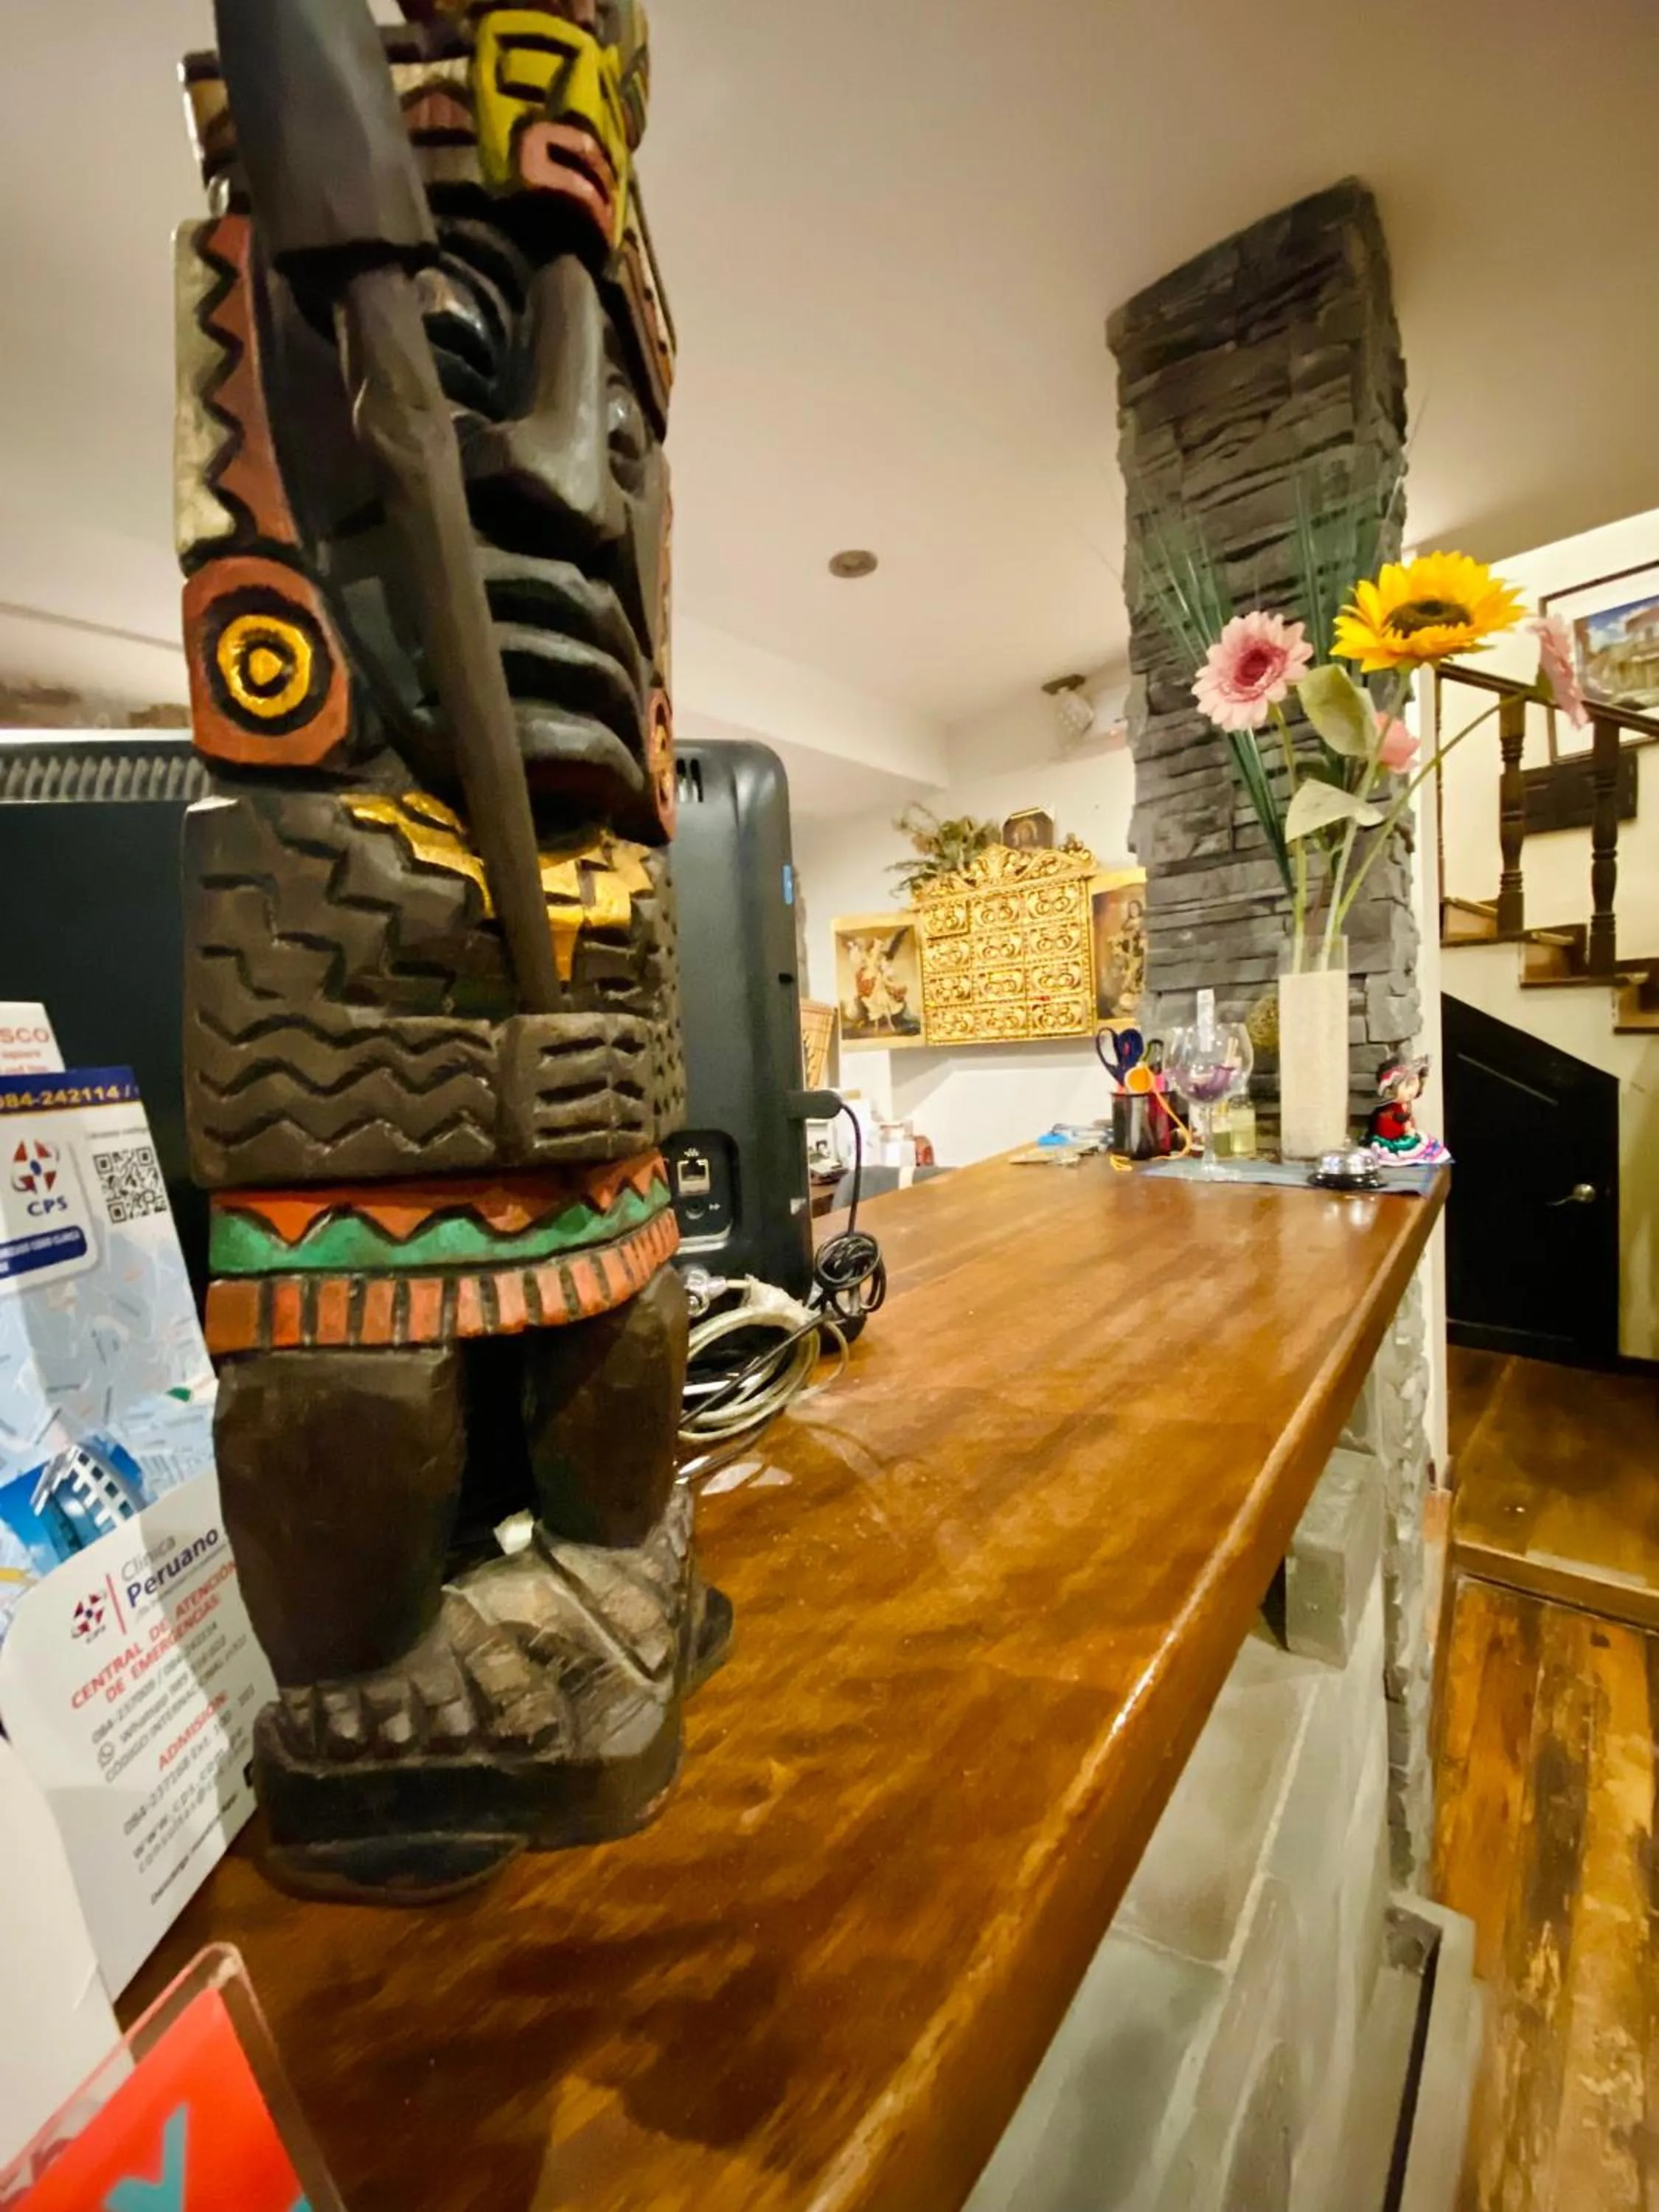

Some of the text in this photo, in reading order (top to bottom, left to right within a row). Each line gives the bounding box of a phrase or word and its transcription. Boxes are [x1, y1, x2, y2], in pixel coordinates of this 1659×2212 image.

[27, 1195, 68, 1217] CPS
[127, 1528, 218, 1608] Peruano
[72, 1642, 142, 1709] CENTRAL
[149, 1618, 171, 1642] DE
[105, 1677, 125, 1703] DE
[131, 1593, 220, 1680] EMERGENCIAS
